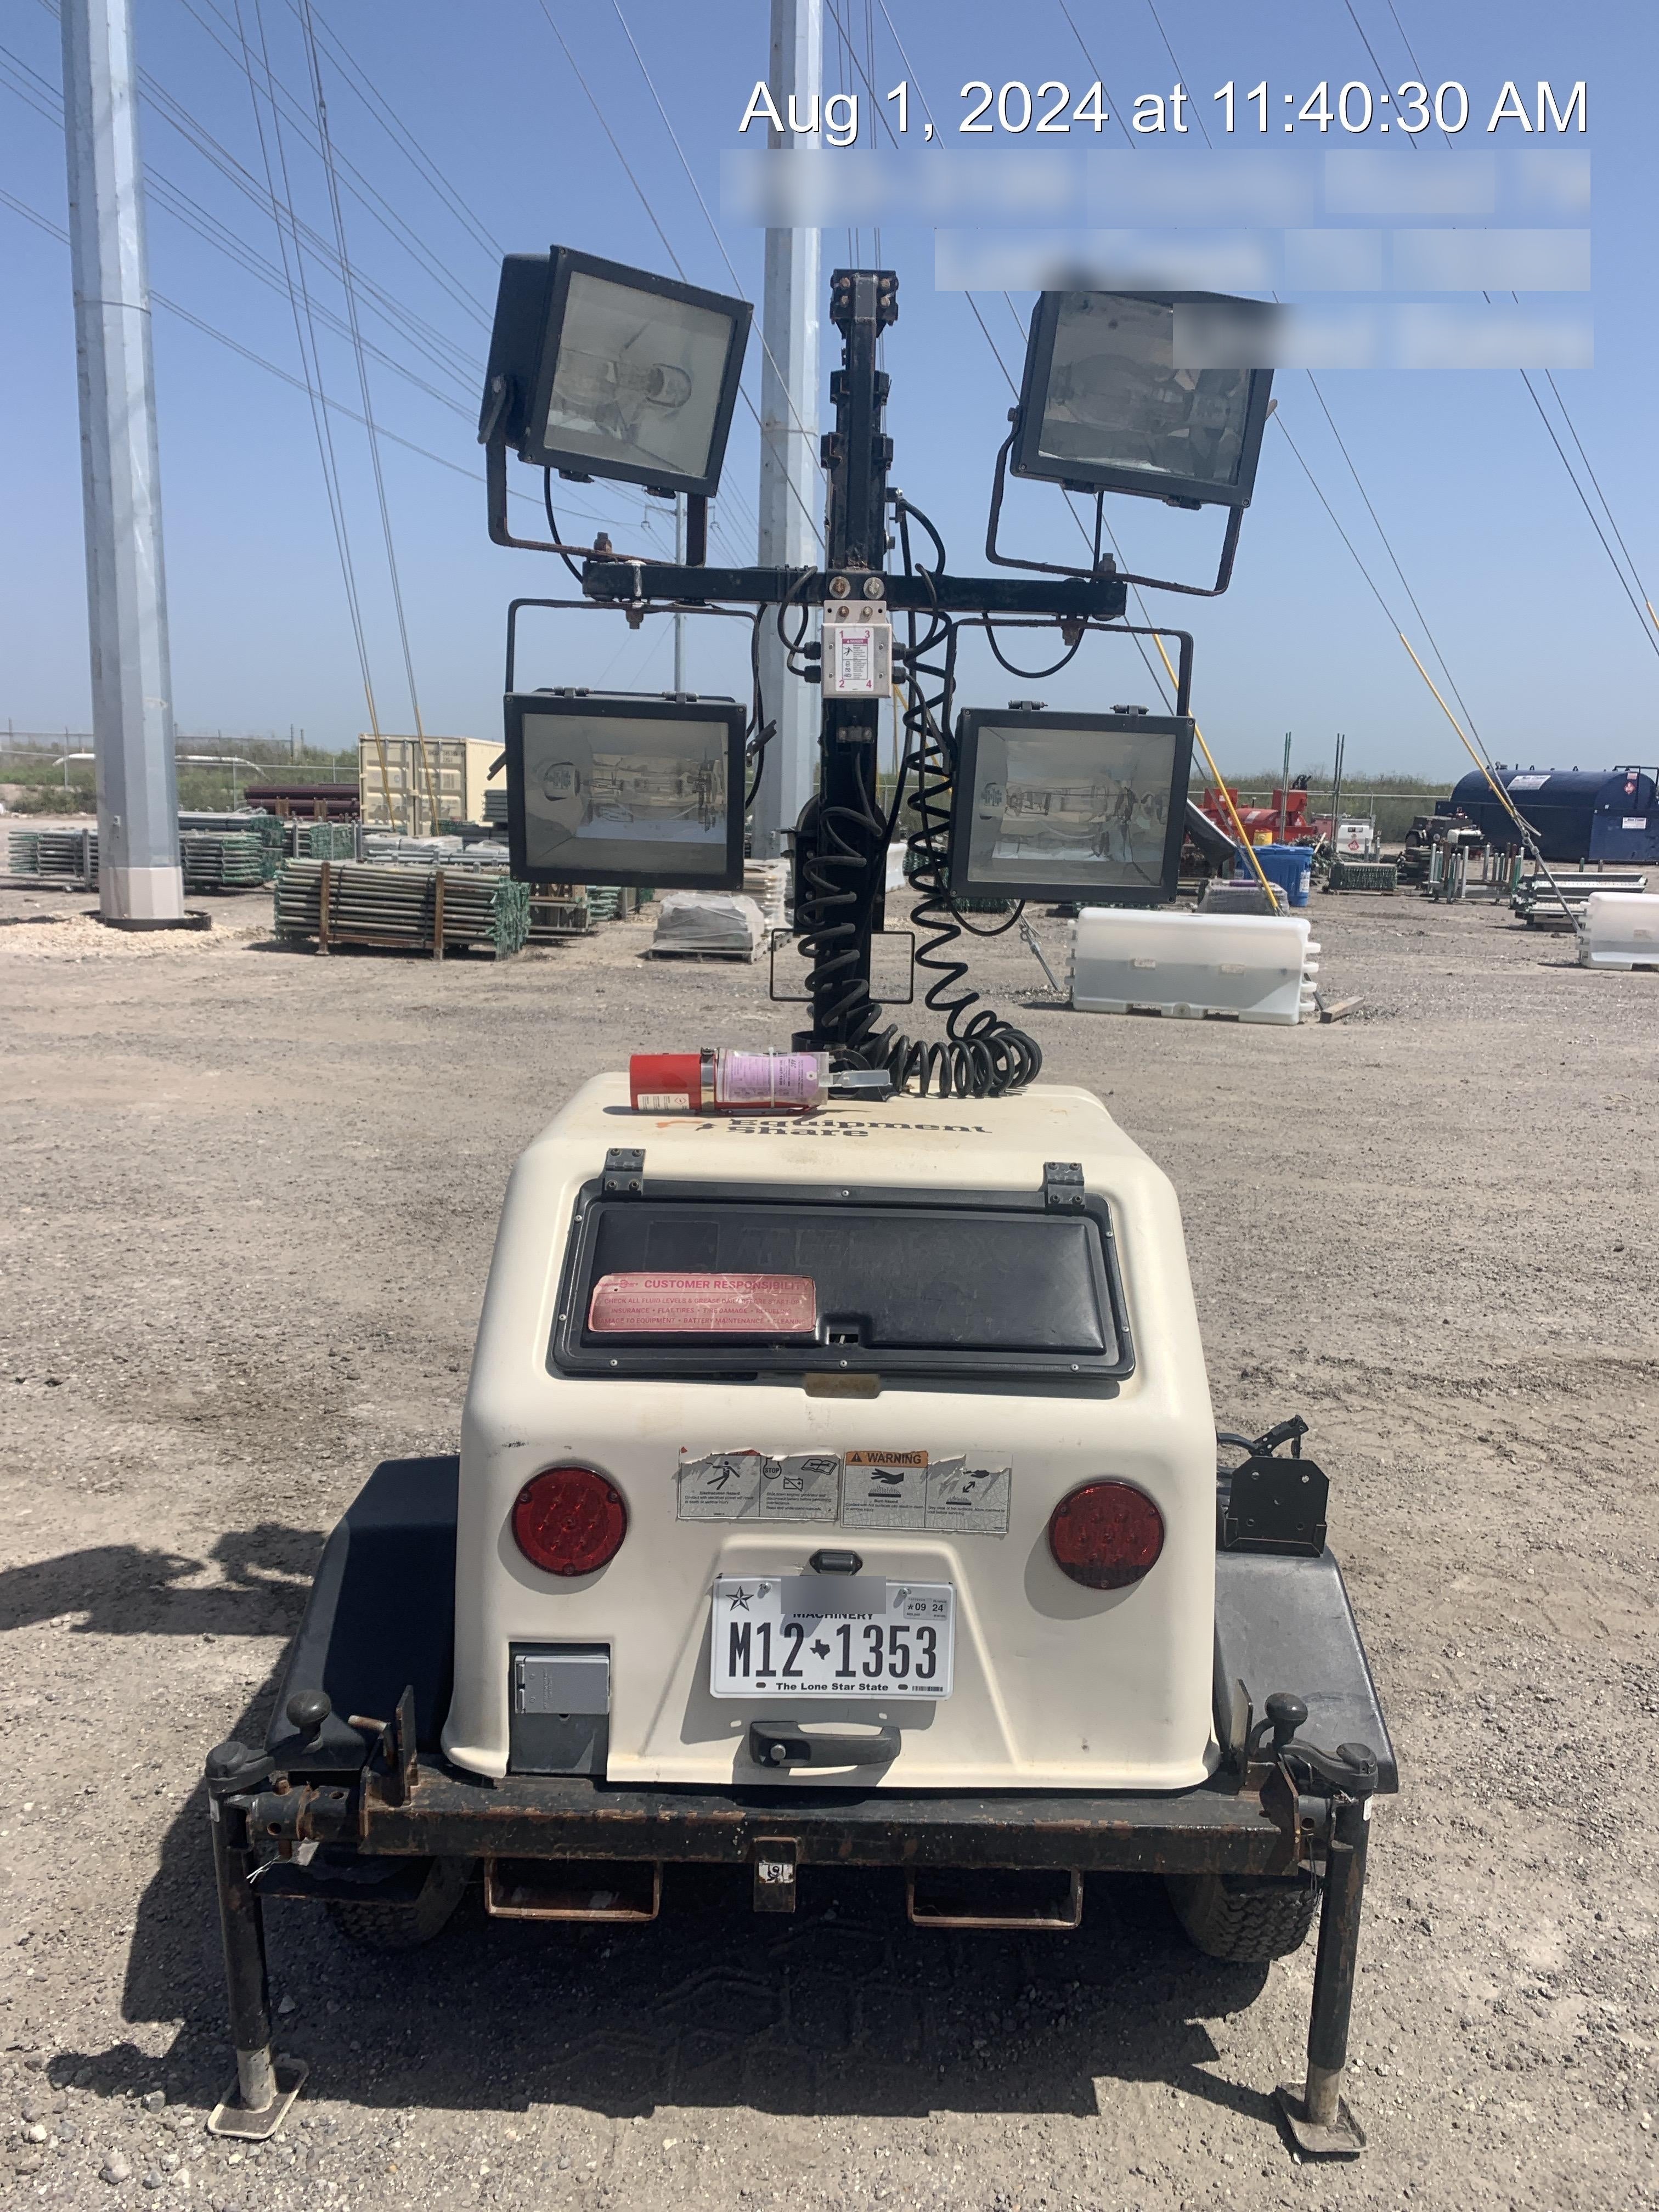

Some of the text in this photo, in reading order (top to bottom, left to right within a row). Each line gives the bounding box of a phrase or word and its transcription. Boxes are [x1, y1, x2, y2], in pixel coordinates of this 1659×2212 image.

[839, 630, 843, 639] 1
[865, 630, 870, 638] 3
[839, 680, 844, 688] 2
[866, 680, 872, 688] 4
[729, 1118, 992, 1133] Equipment
[726, 1126, 868, 1137] Share
[644, 1280, 809, 1290] CUSTOMER RESPONSIBILITY
[867, 1453, 921, 1464] WARNING
[915, 1603, 944, 1612] 09 24
[729, 1622, 937, 1679] M12 1353
[776, 1683, 798, 1691] The
[801, 1683, 827, 1691] Lone
[832, 1683, 855, 1691] Star
